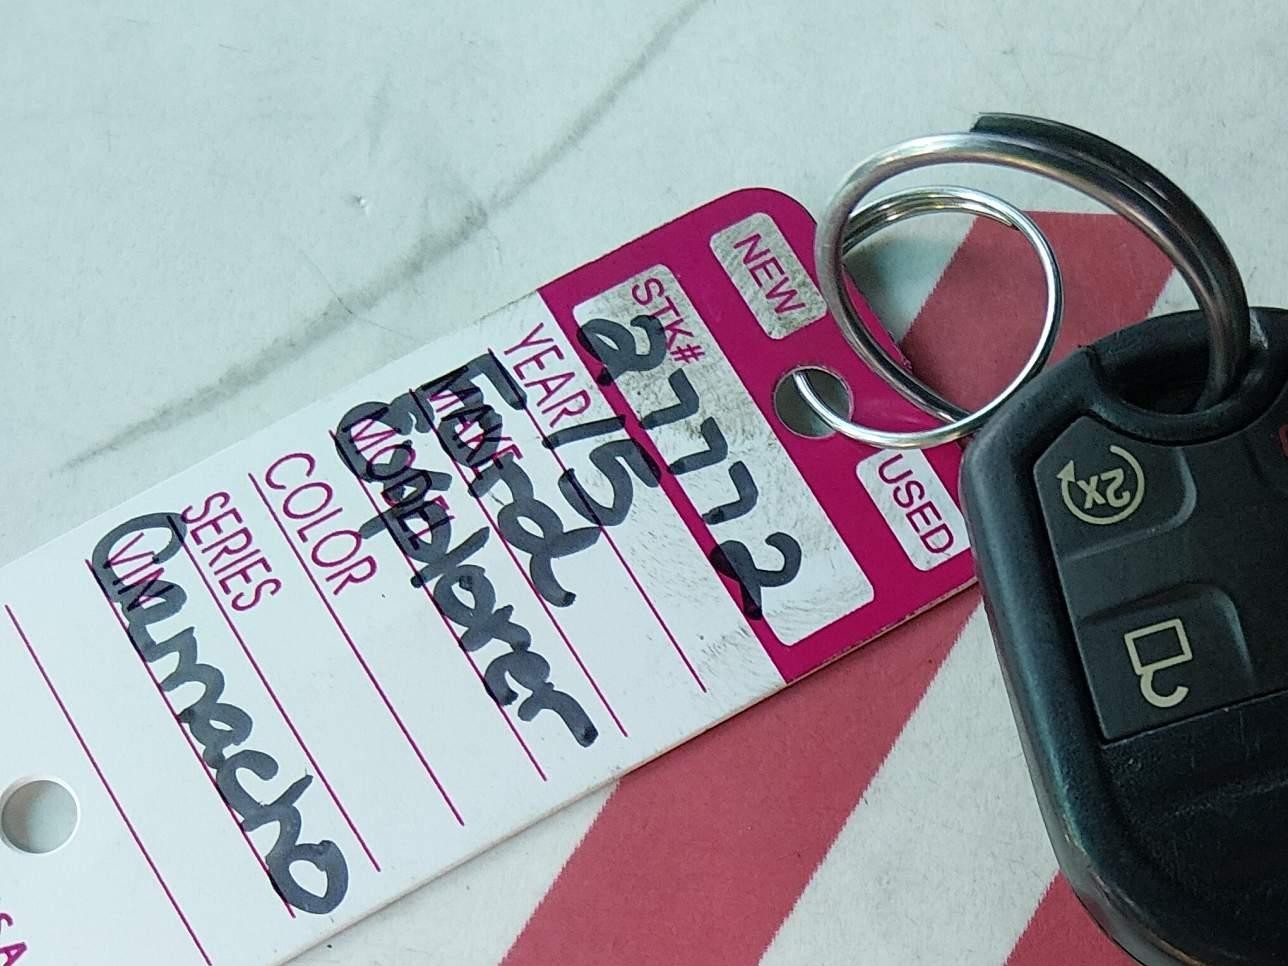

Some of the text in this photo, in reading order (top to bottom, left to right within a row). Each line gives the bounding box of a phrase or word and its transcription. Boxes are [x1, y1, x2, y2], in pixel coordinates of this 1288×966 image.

[631, 277, 705, 364] STK#
[733, 232, 805, 316] NEW
[421, 365, 525, 480] MAKE
[504, 323, 592, 427] YEAR
[264, 452, 378, 596] COLOR
[341, 406, 455, 551] MODEL
[420, 353, 602, 607] Ford
[543, 415, 662, 527] 15
[579, 315, 800, 620] 27772
[877, 453, 955, 556] USED
[102, 530, 163, 612] VIN
[180, 491, 282, 612] SERIES
[334, 400, 600, 748] Explorer
[92, 512, 349, 916] Camacho
